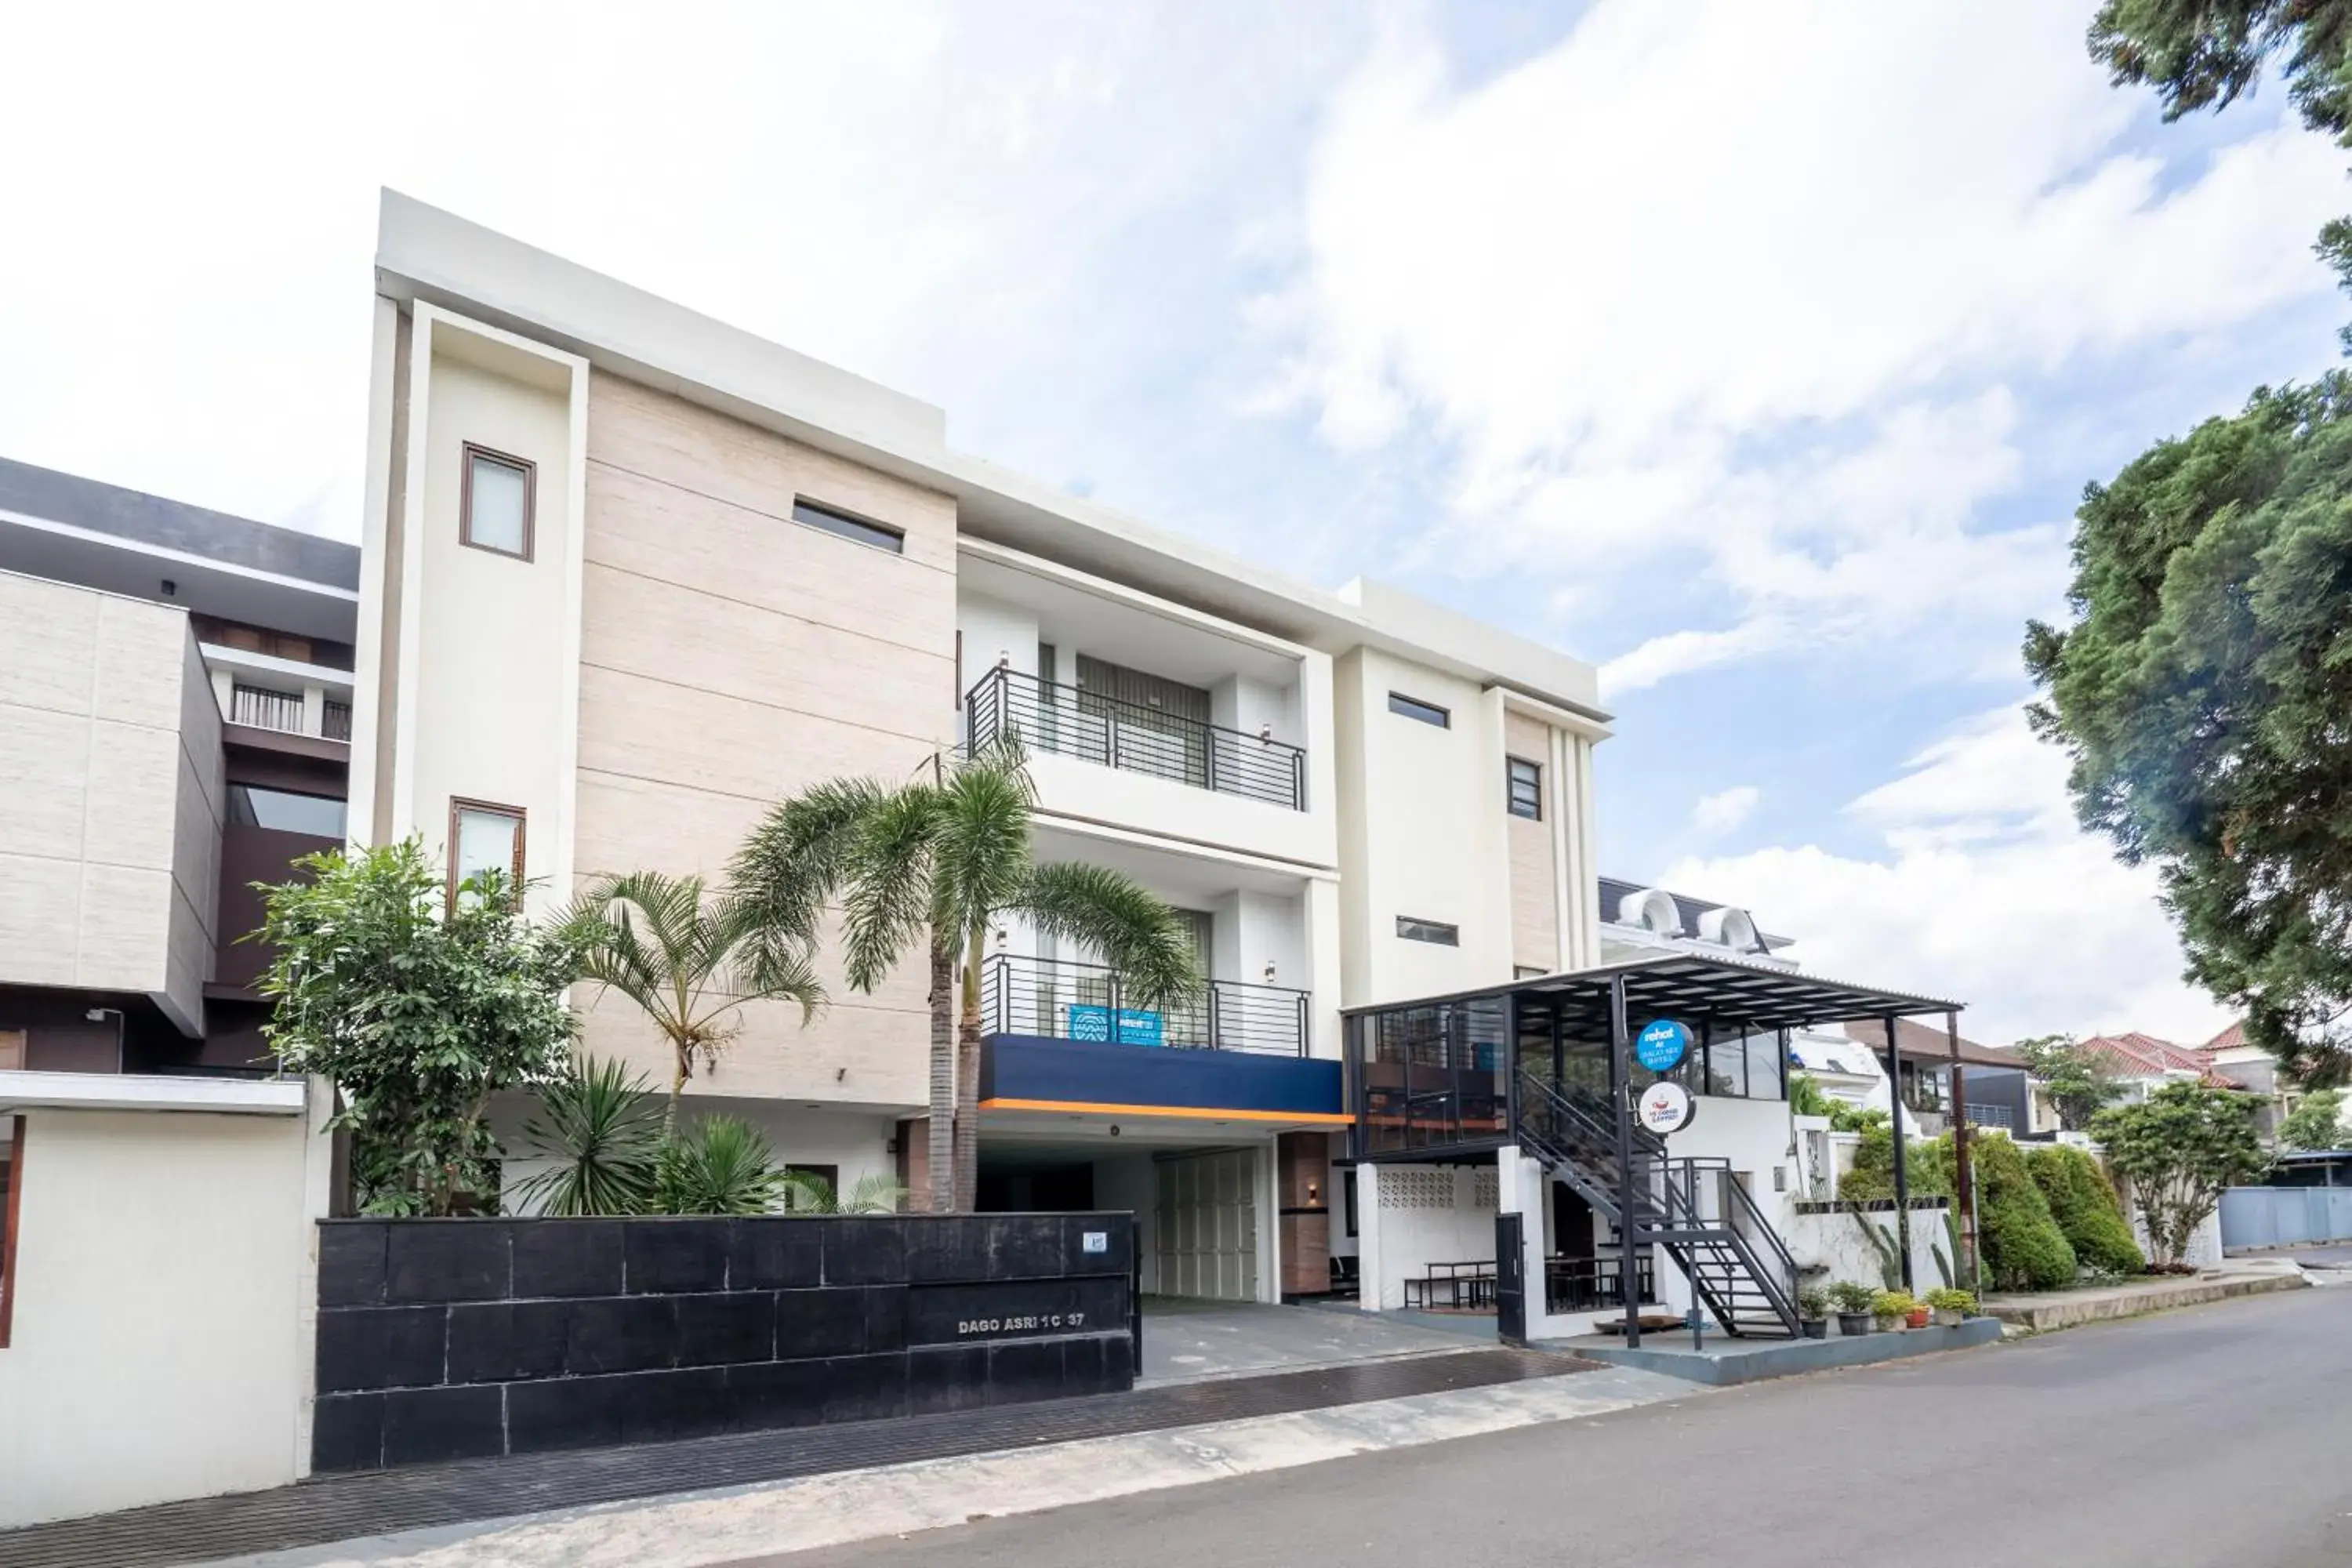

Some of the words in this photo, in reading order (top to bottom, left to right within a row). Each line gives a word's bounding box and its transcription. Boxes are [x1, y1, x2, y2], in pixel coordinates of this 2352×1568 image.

[958, 1319, 1000, 1334] DAGO
[1004, 1317, 1037, 1330] ASRI
[1051, 1315, 1061, 1327] C
[1067, 1312, 1085, 1327] 37
